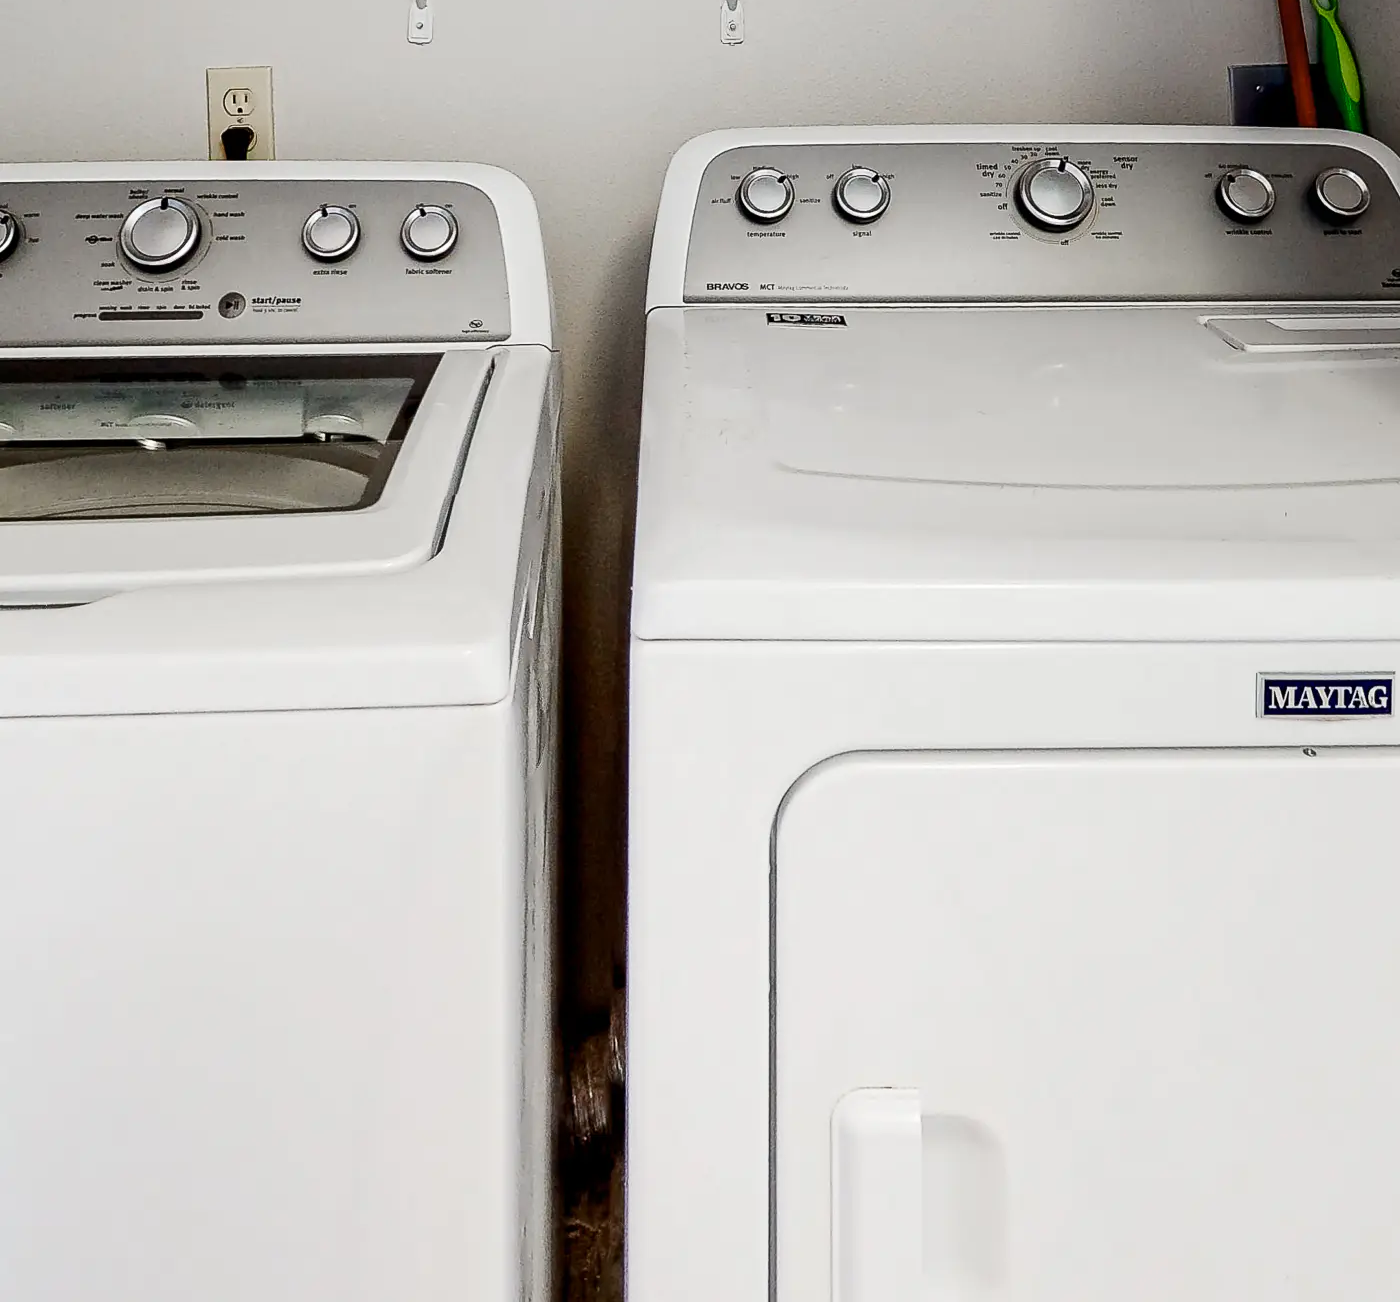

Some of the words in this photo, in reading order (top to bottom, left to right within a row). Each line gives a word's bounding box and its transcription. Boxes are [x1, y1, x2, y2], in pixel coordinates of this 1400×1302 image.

[747, 231, 786, 239] temperature
[853, 230, 872, 238] signal
[706, 283, 749, 291] BRAVOS
[760, 283, 775, 291] MCT
[252, 296, 302, 305] start/pause
[770, 313, 801, 323] 10
[1268, 685, 1389, 709] MAYTAG
